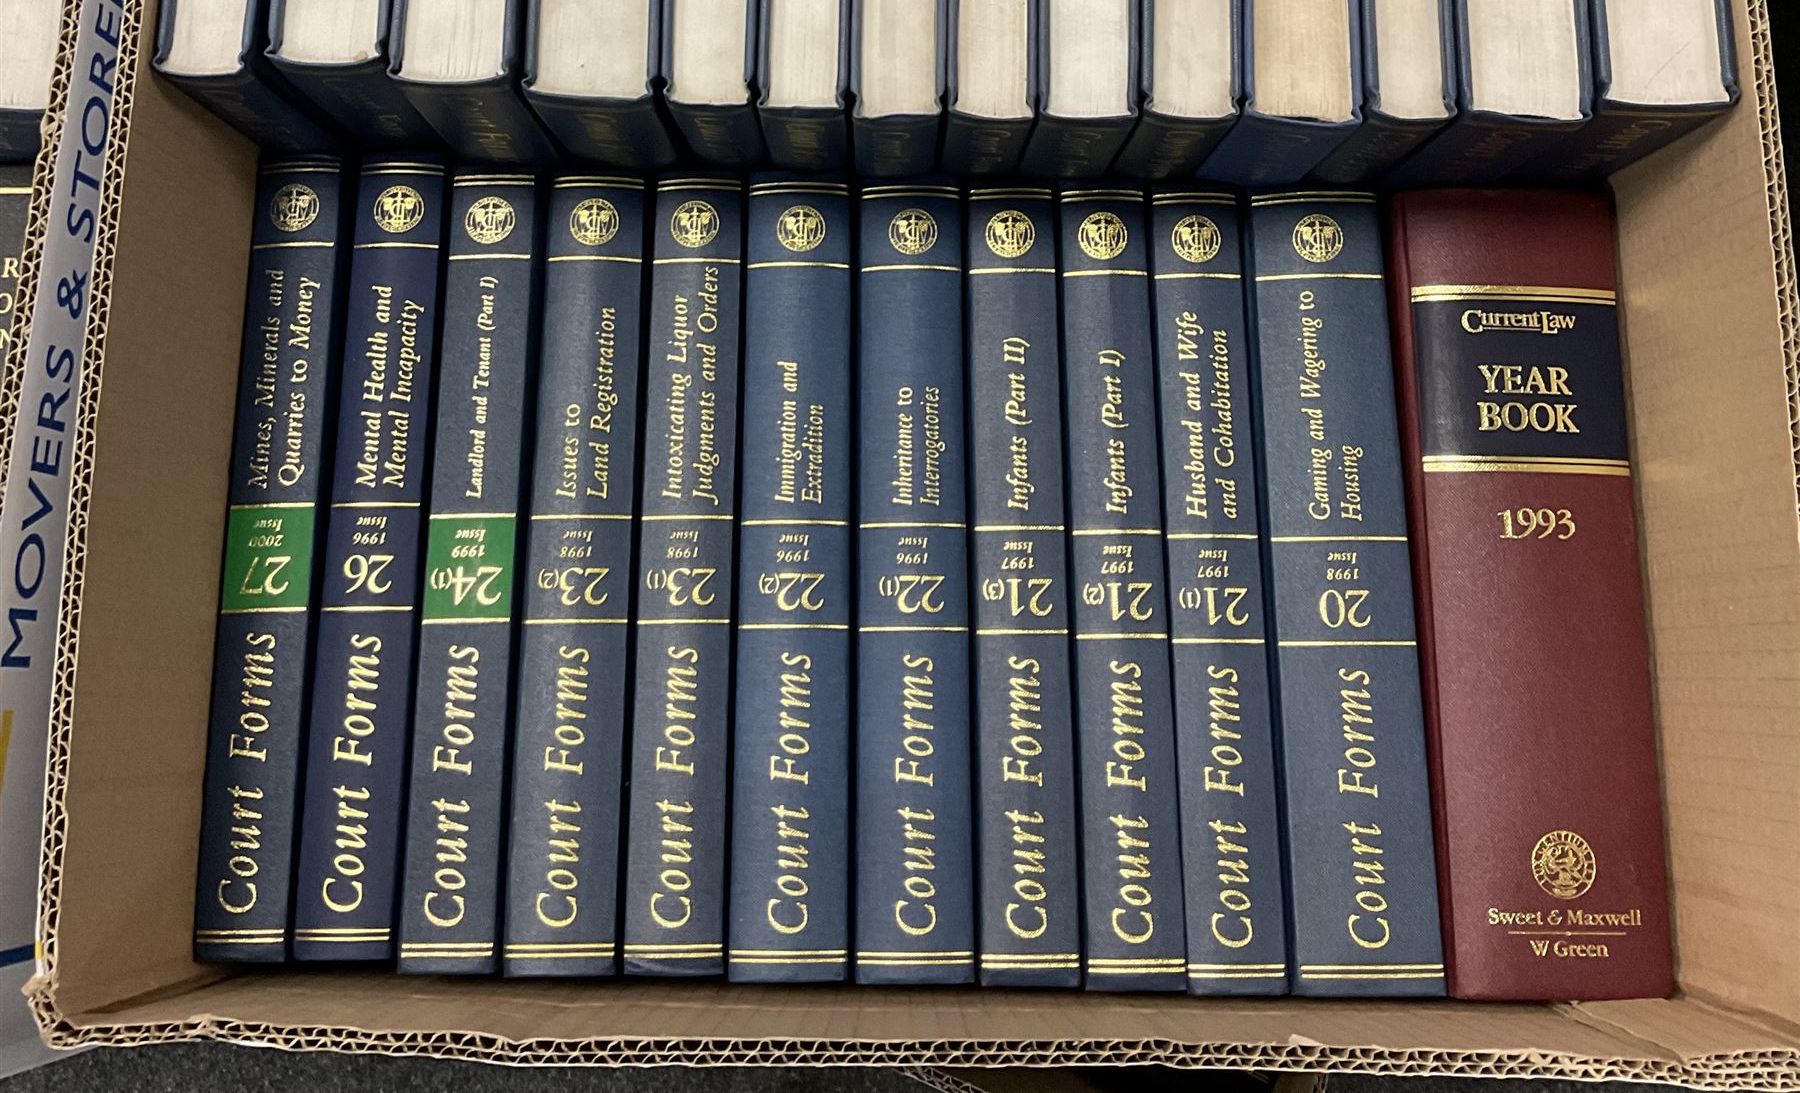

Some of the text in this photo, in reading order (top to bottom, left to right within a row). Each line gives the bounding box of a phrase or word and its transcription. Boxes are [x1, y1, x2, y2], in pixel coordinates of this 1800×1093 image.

[248, 271, 283, 489] Mines, Minerals and
[278, 277, 320, 486] Quarries to Money
[356, 286, 392, 487] Mental Health and
[383, 300, 424, 488] Mental Incapacity
[466, 277, 498, 498] Landlord and Tenant (Part I)
[587, 308, 617, 499] Land Registration
[662, 295, 693, 498] Intoxicating Liquor
[693, 267, 719, 505] Judgments and Orders
[1176, 312, 1207, 518] Husband and Wife
[1297, 291, 1332, 520] Gaming and Wagering to
[1477, 401, 1580, 433] BOOK
[1478, 365, 1572, 395] YEAR
[556, 404, 580, 498] Issues to
[775, 361, 801, 503] Immigration and
[801, 405, 823, 503] Extradition
[892, 387, 912, 505] Inheritance to
[920, 387, 945, 506] Interrogatories
[1003, 338, 1034, 510] Infants (Part II)
[1098, 350, 1132, 513] Infants (Part I)
[1211, 331, 1237, 518] and Cohabitation
[1, 344, 75, 668] MOVERS
[57, 268, 87, 320] &
[1338, 446, 1363, 521] Housing
[249, 535, 283, 547] 2000
[256, 519, 282, 531] Issue
[353, 533, 386, 544] 1996
[357, 517, 387, 529] Issue
[452, 545, 485, 558] 1999
[455, 529, 486, 542] Issue
[559, 546, 591, 557] 1998
[563, 531, 592, 542] Issue
[667, 547, 698, 558] 1998
[670, 531, 698, 542] Issue
[777, 550, 808, 562] 1996
[779, 535, 808, 546] Issue
[897, 553, 927, 564] 1996
[898, 537, 927, 548] Issue
[1003, 542, 1032, 553] Issue
[1103, 545, 1132, 557] Issue
[1199, 549, 1227, 561] Issue
[1328, 553, 1356, 564] Issue
[1497, 508, 1576, 540] 1993
[240, 556, 291, 595] 27
[344, 555, 394, 593] 26
[1001, 557, 1034, 569] 1997
[1101, 561, 1133, 574] 1997
[1197, 566, 1228, 578] 1997
[1327, 568, 1358, 580] 1998
[1319, 590, 1370, 627] 20
[219, 633, 275, 913] Court Forms
[323, 634, 381, 912] Court Forms
[424, 645, 479, 927] Court Forms
[536, 646, 589, 927] Court Forms
[651, 646, 697, 928] Court Forms
[768, 652, 811, 934] Court Forms
[895, 655, 936, 935] Court Forms
[1002, 656, 1047, 938] Court Forms
[1106, 661, 1153, 943] Court Forms
[1204, 666, 1252, 948] Court Forms
[1338, 668, 1389, 948] Court Forms
[1488, 908, 1642, 926] Sweet & Maxwell
[1529, 940, 1609, 958] W Green
